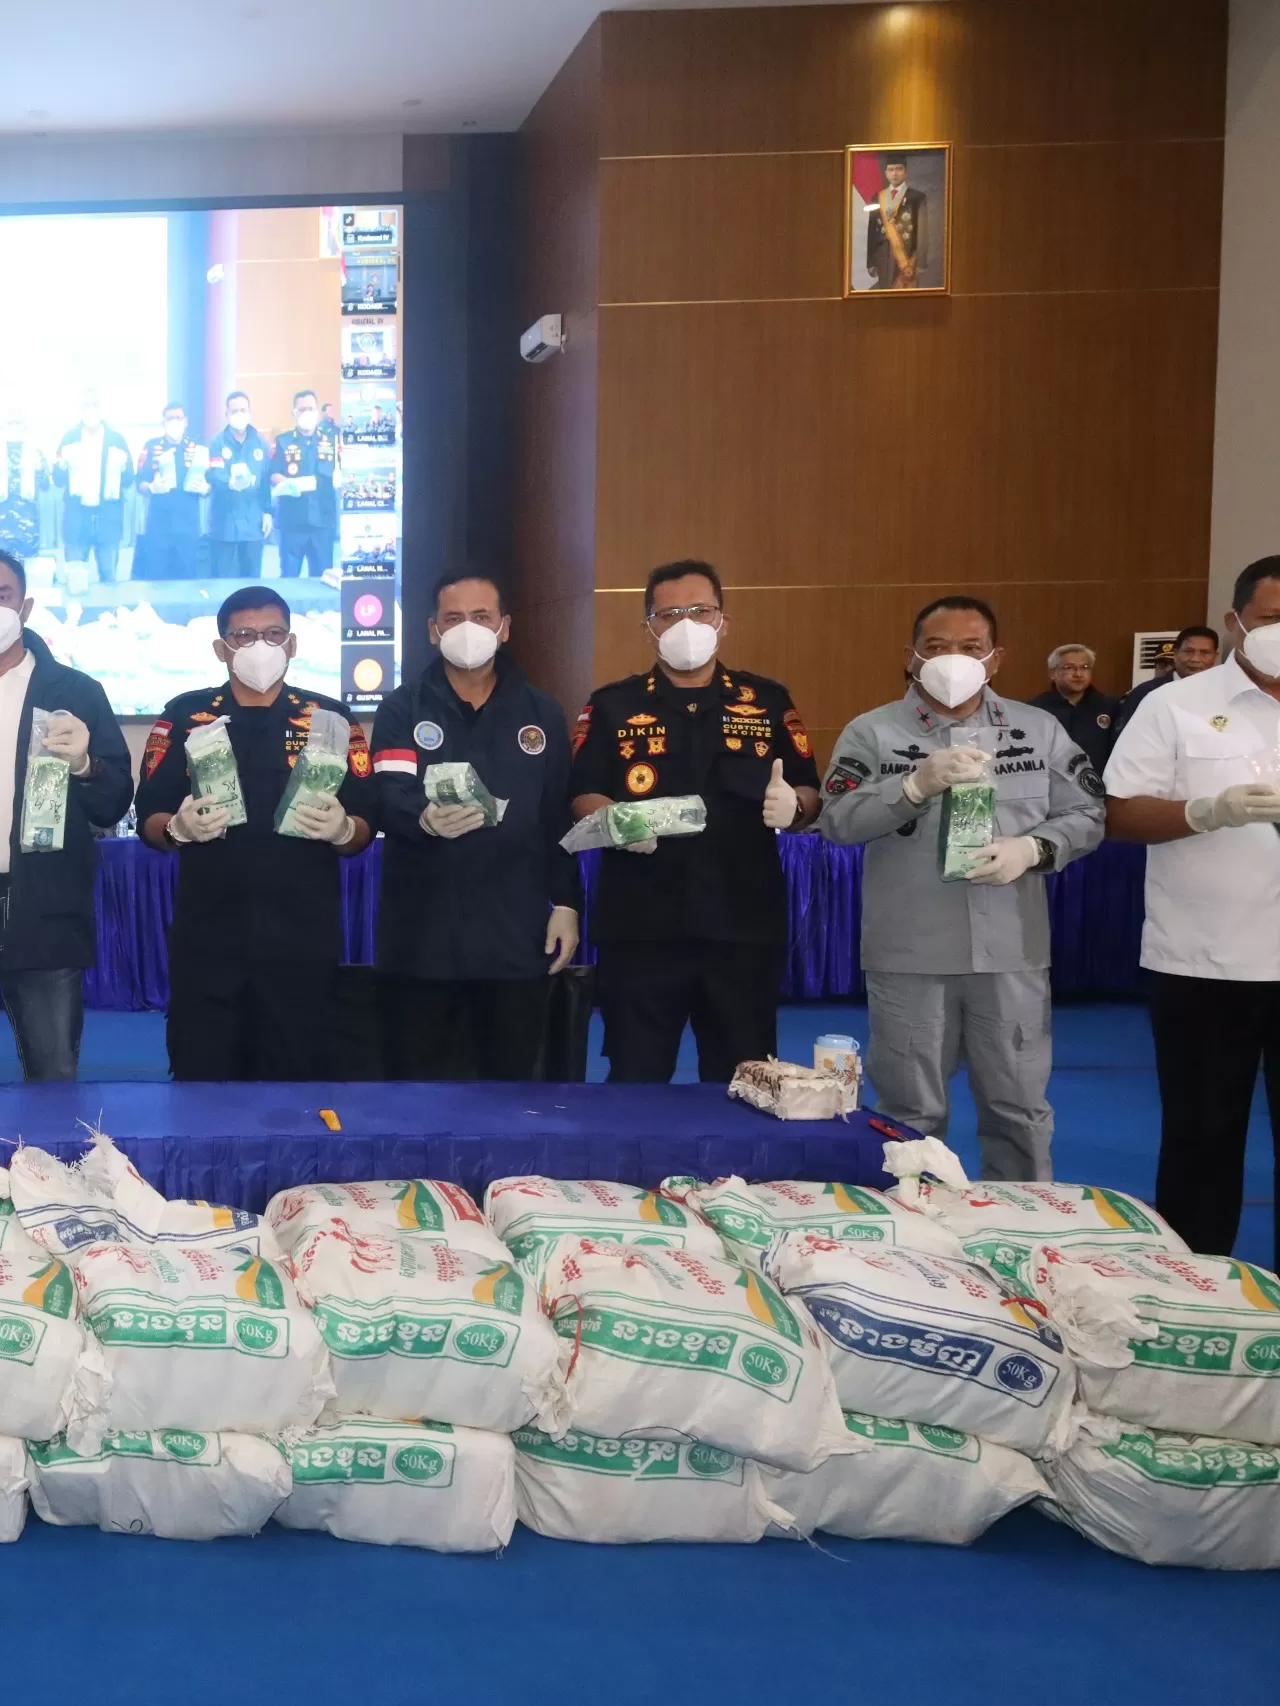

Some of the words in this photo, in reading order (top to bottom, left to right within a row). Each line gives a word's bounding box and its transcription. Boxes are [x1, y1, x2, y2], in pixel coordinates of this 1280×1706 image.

[618, 725, 666, 738] DIKIN
[723, 723, 772, 732] CUSTOMS
[723, 728, 772, 738] EXCISE
[461, 1331, 500, 1352] 50Kg
[747, 1350, 783, 1381] 50Kg
[1004, 1360, 1038, 1388] 50Kg
[399, 1453, 438, 1473] 50Kg
